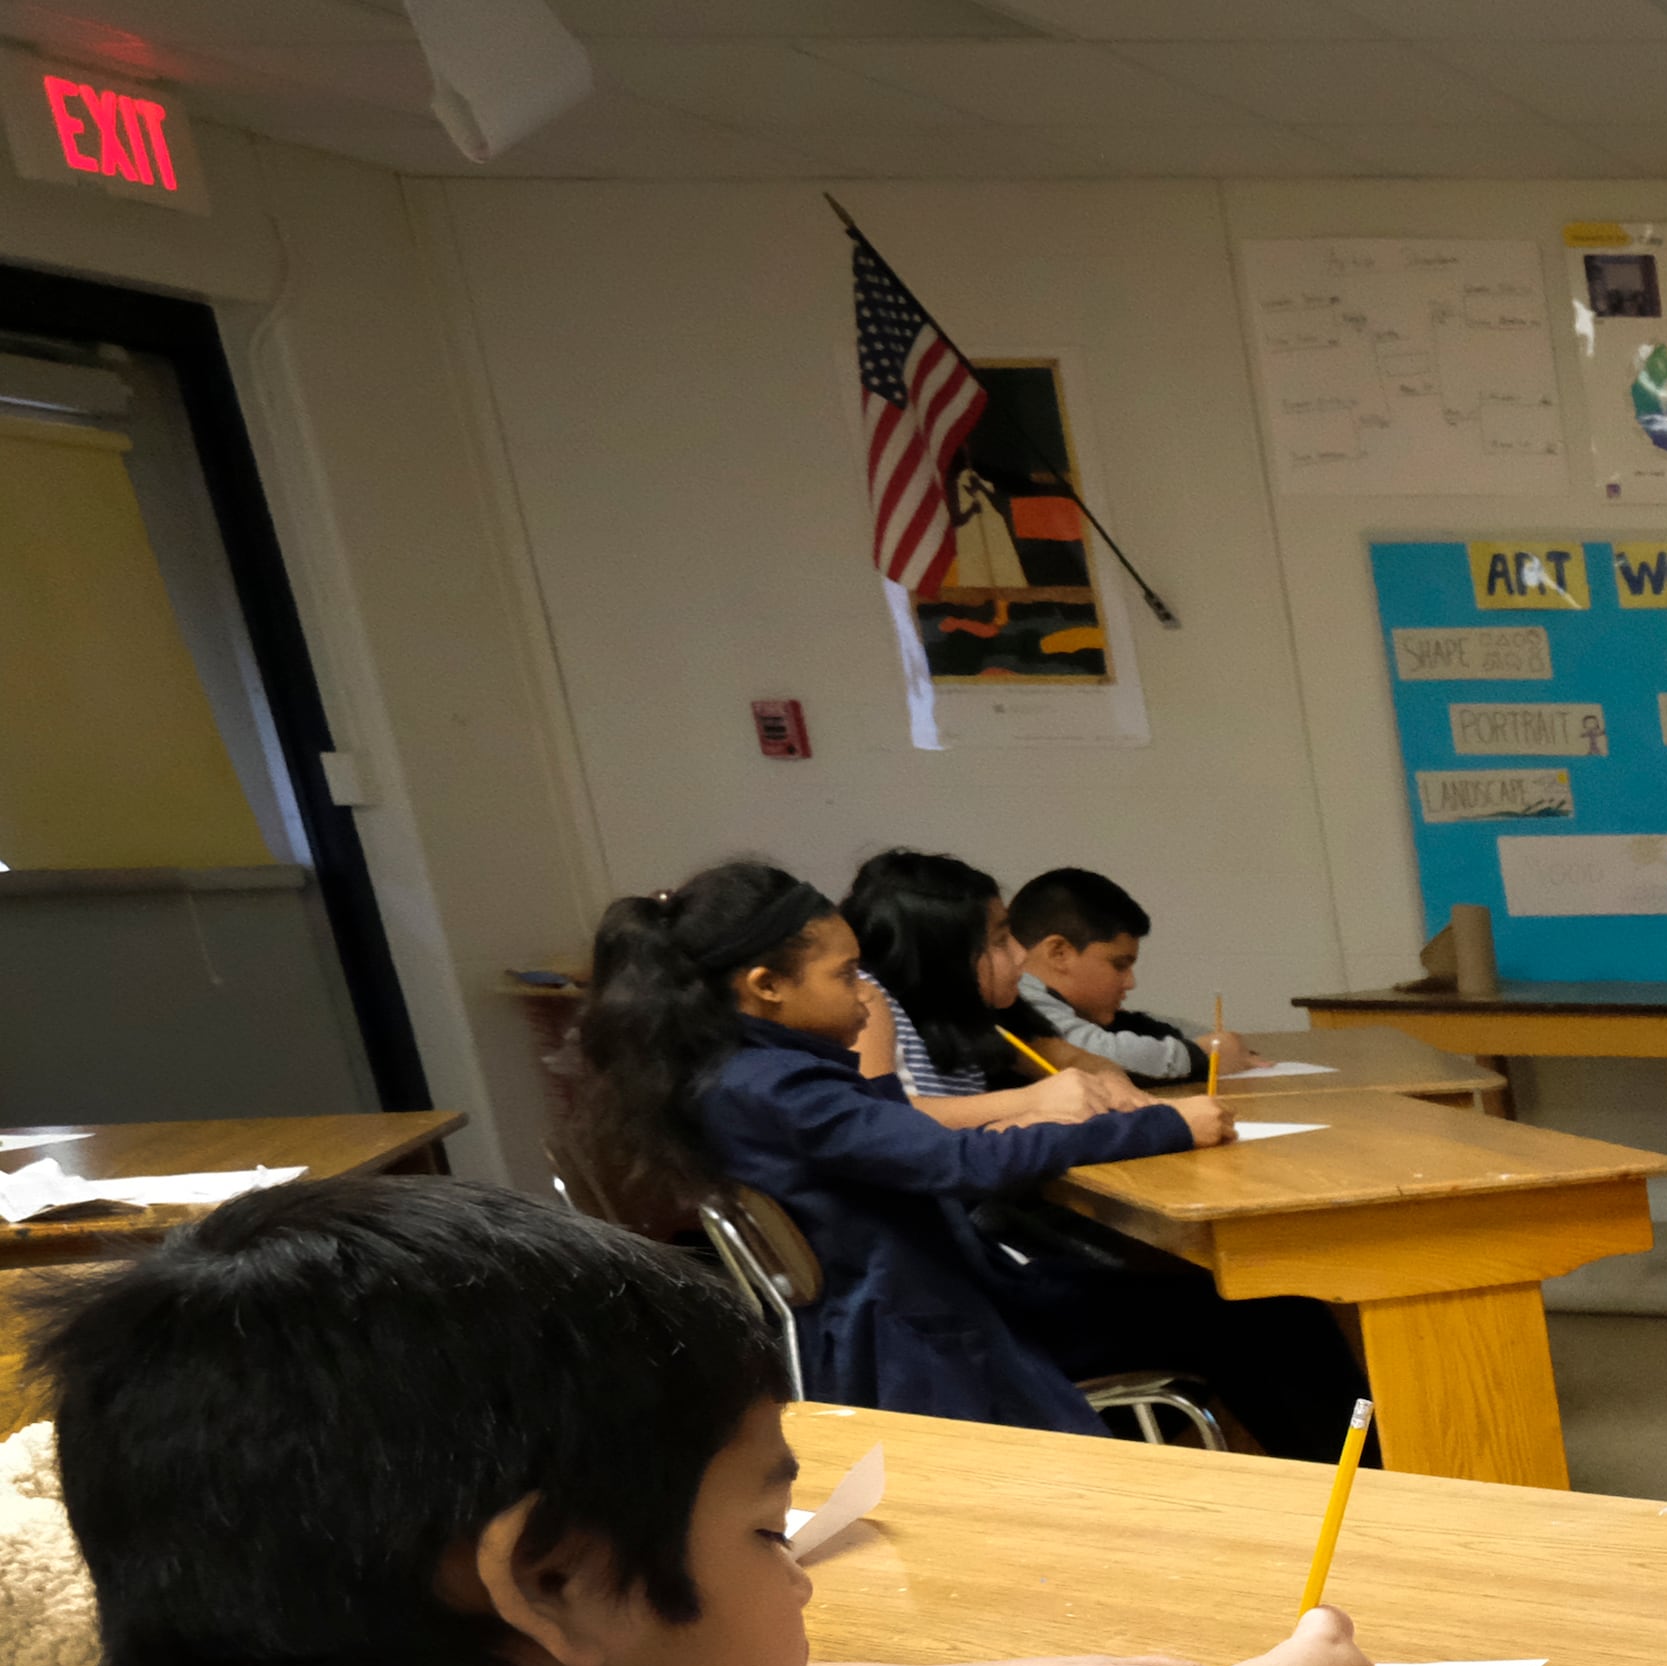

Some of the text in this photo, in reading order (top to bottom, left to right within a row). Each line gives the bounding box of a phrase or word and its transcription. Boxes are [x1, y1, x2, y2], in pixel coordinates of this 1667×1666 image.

[43, 75, 178, 191] EXIT
[1486, 551, 1571, 596] ART
[1402, 637, 1471, 672] SHAPE
[1459, 709, 1571, 746] PORTRAIT
[1422, 778, 1533, 813] LANDSCAPE
